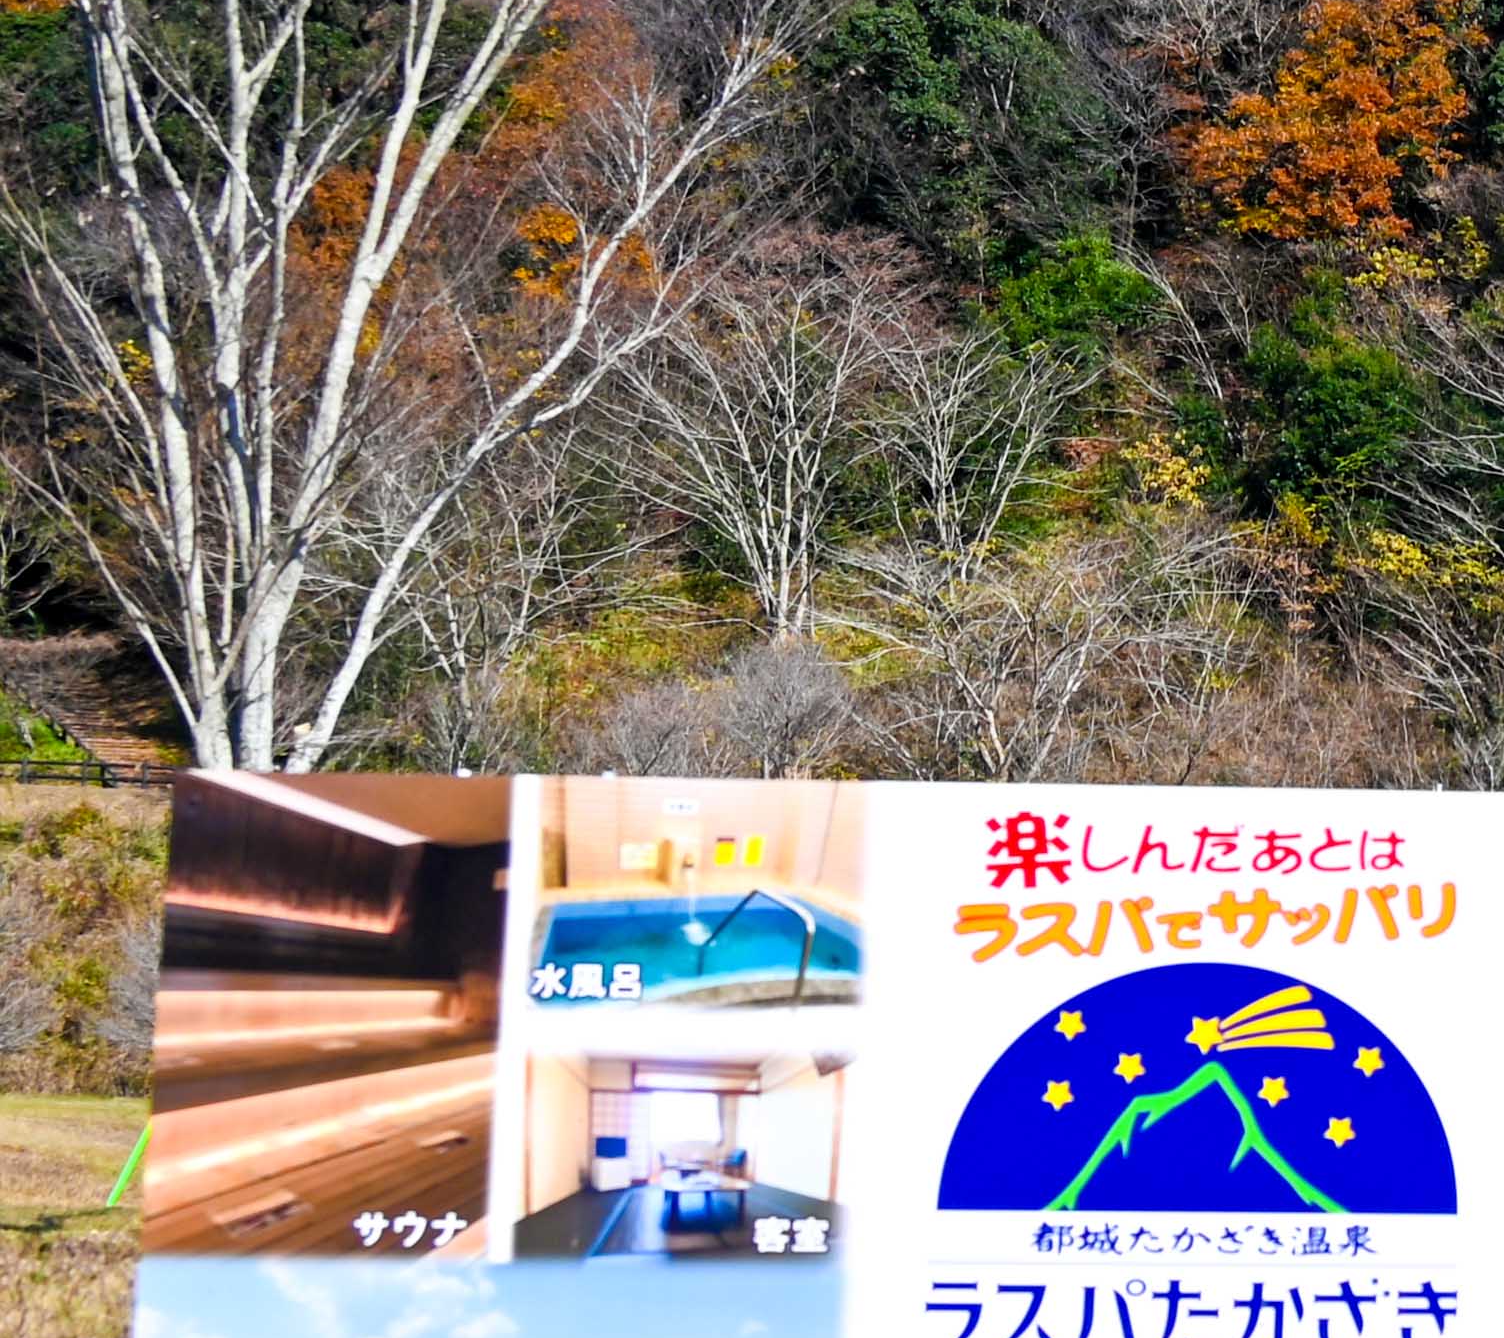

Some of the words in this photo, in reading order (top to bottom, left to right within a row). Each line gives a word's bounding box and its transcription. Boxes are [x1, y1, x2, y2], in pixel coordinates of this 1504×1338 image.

[985, 811, 1406, 889] 楽しんだあとは
[953, 881, 1459, 964] ラスパでサッパリ
[531, 961, 643, 1000] 水風呂
[352, 1209, 468, 1248] サウナ
[1031, 1221, 1377, 1257] 都城たかざき温泉
